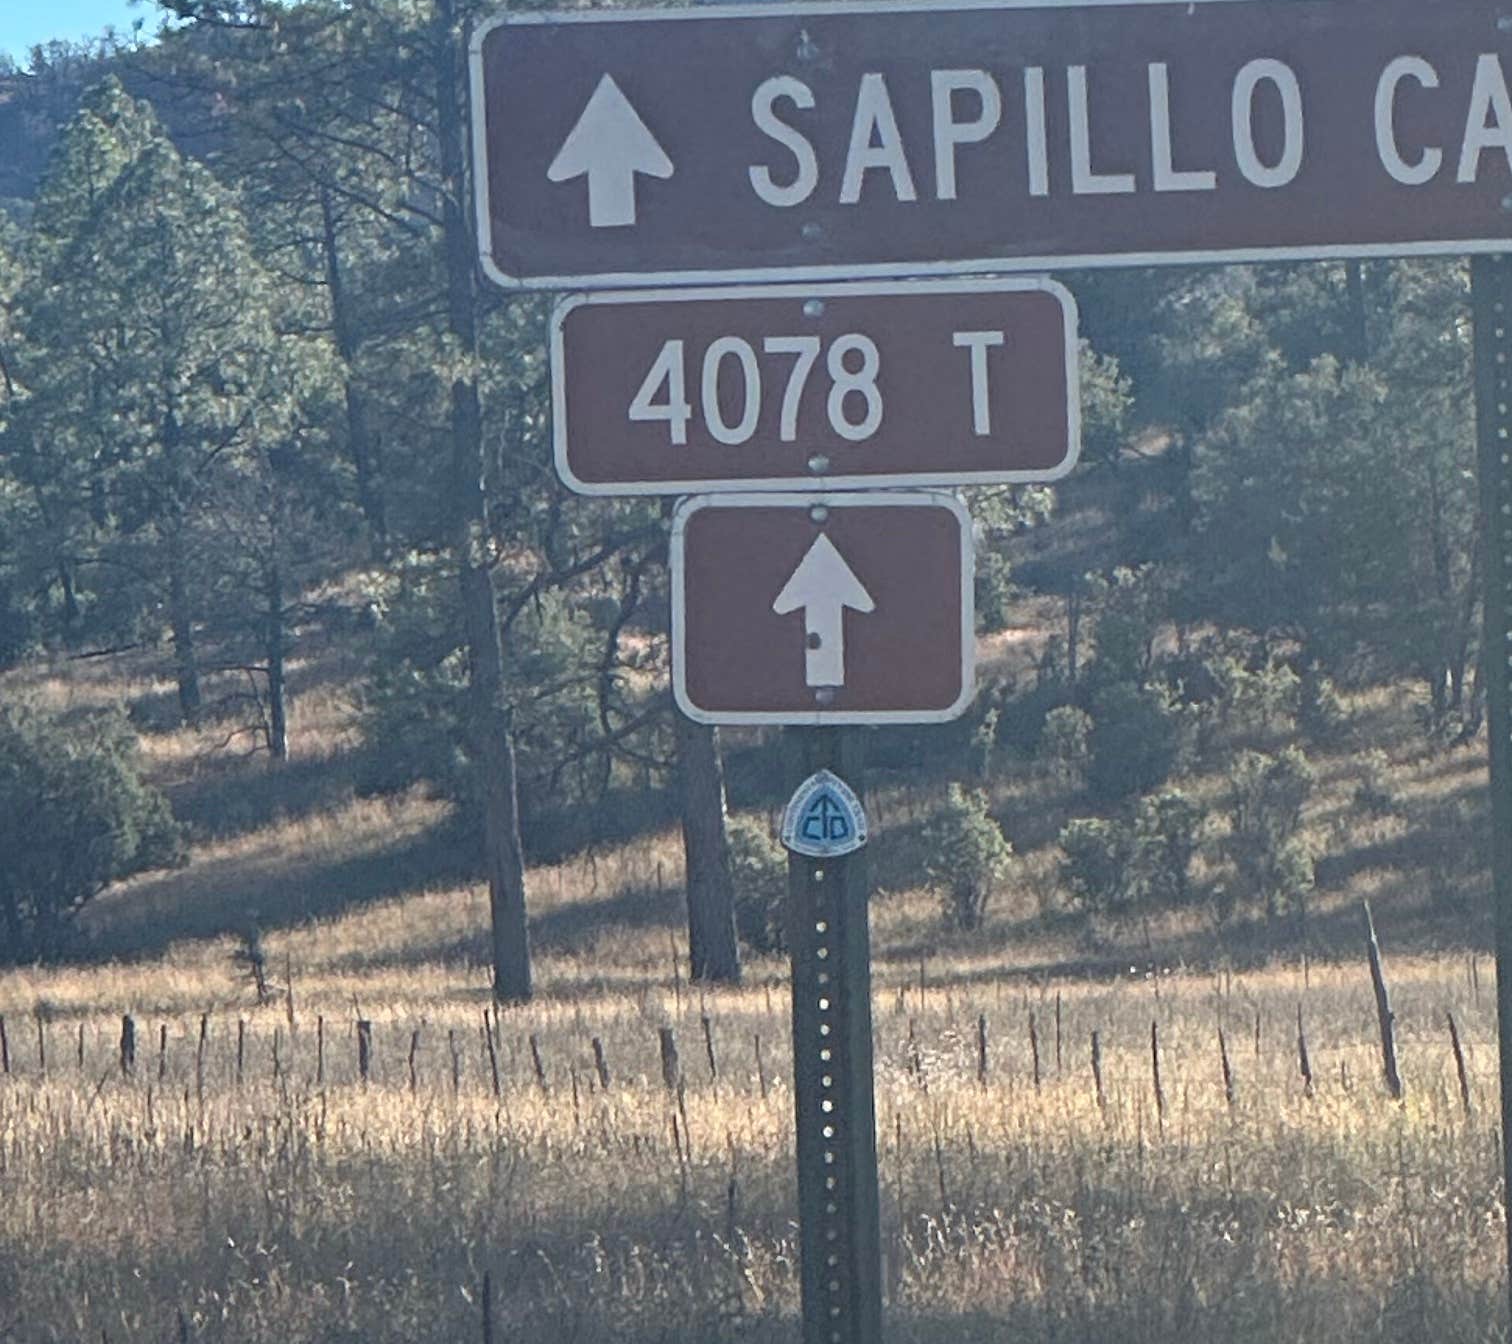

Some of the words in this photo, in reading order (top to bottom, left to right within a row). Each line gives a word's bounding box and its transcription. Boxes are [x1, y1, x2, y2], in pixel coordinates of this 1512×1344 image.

[749, 58, 1303, 207] SAPILLO
[629, 333, 883, 445] 4078
[953, 330, 1004, 436] T
